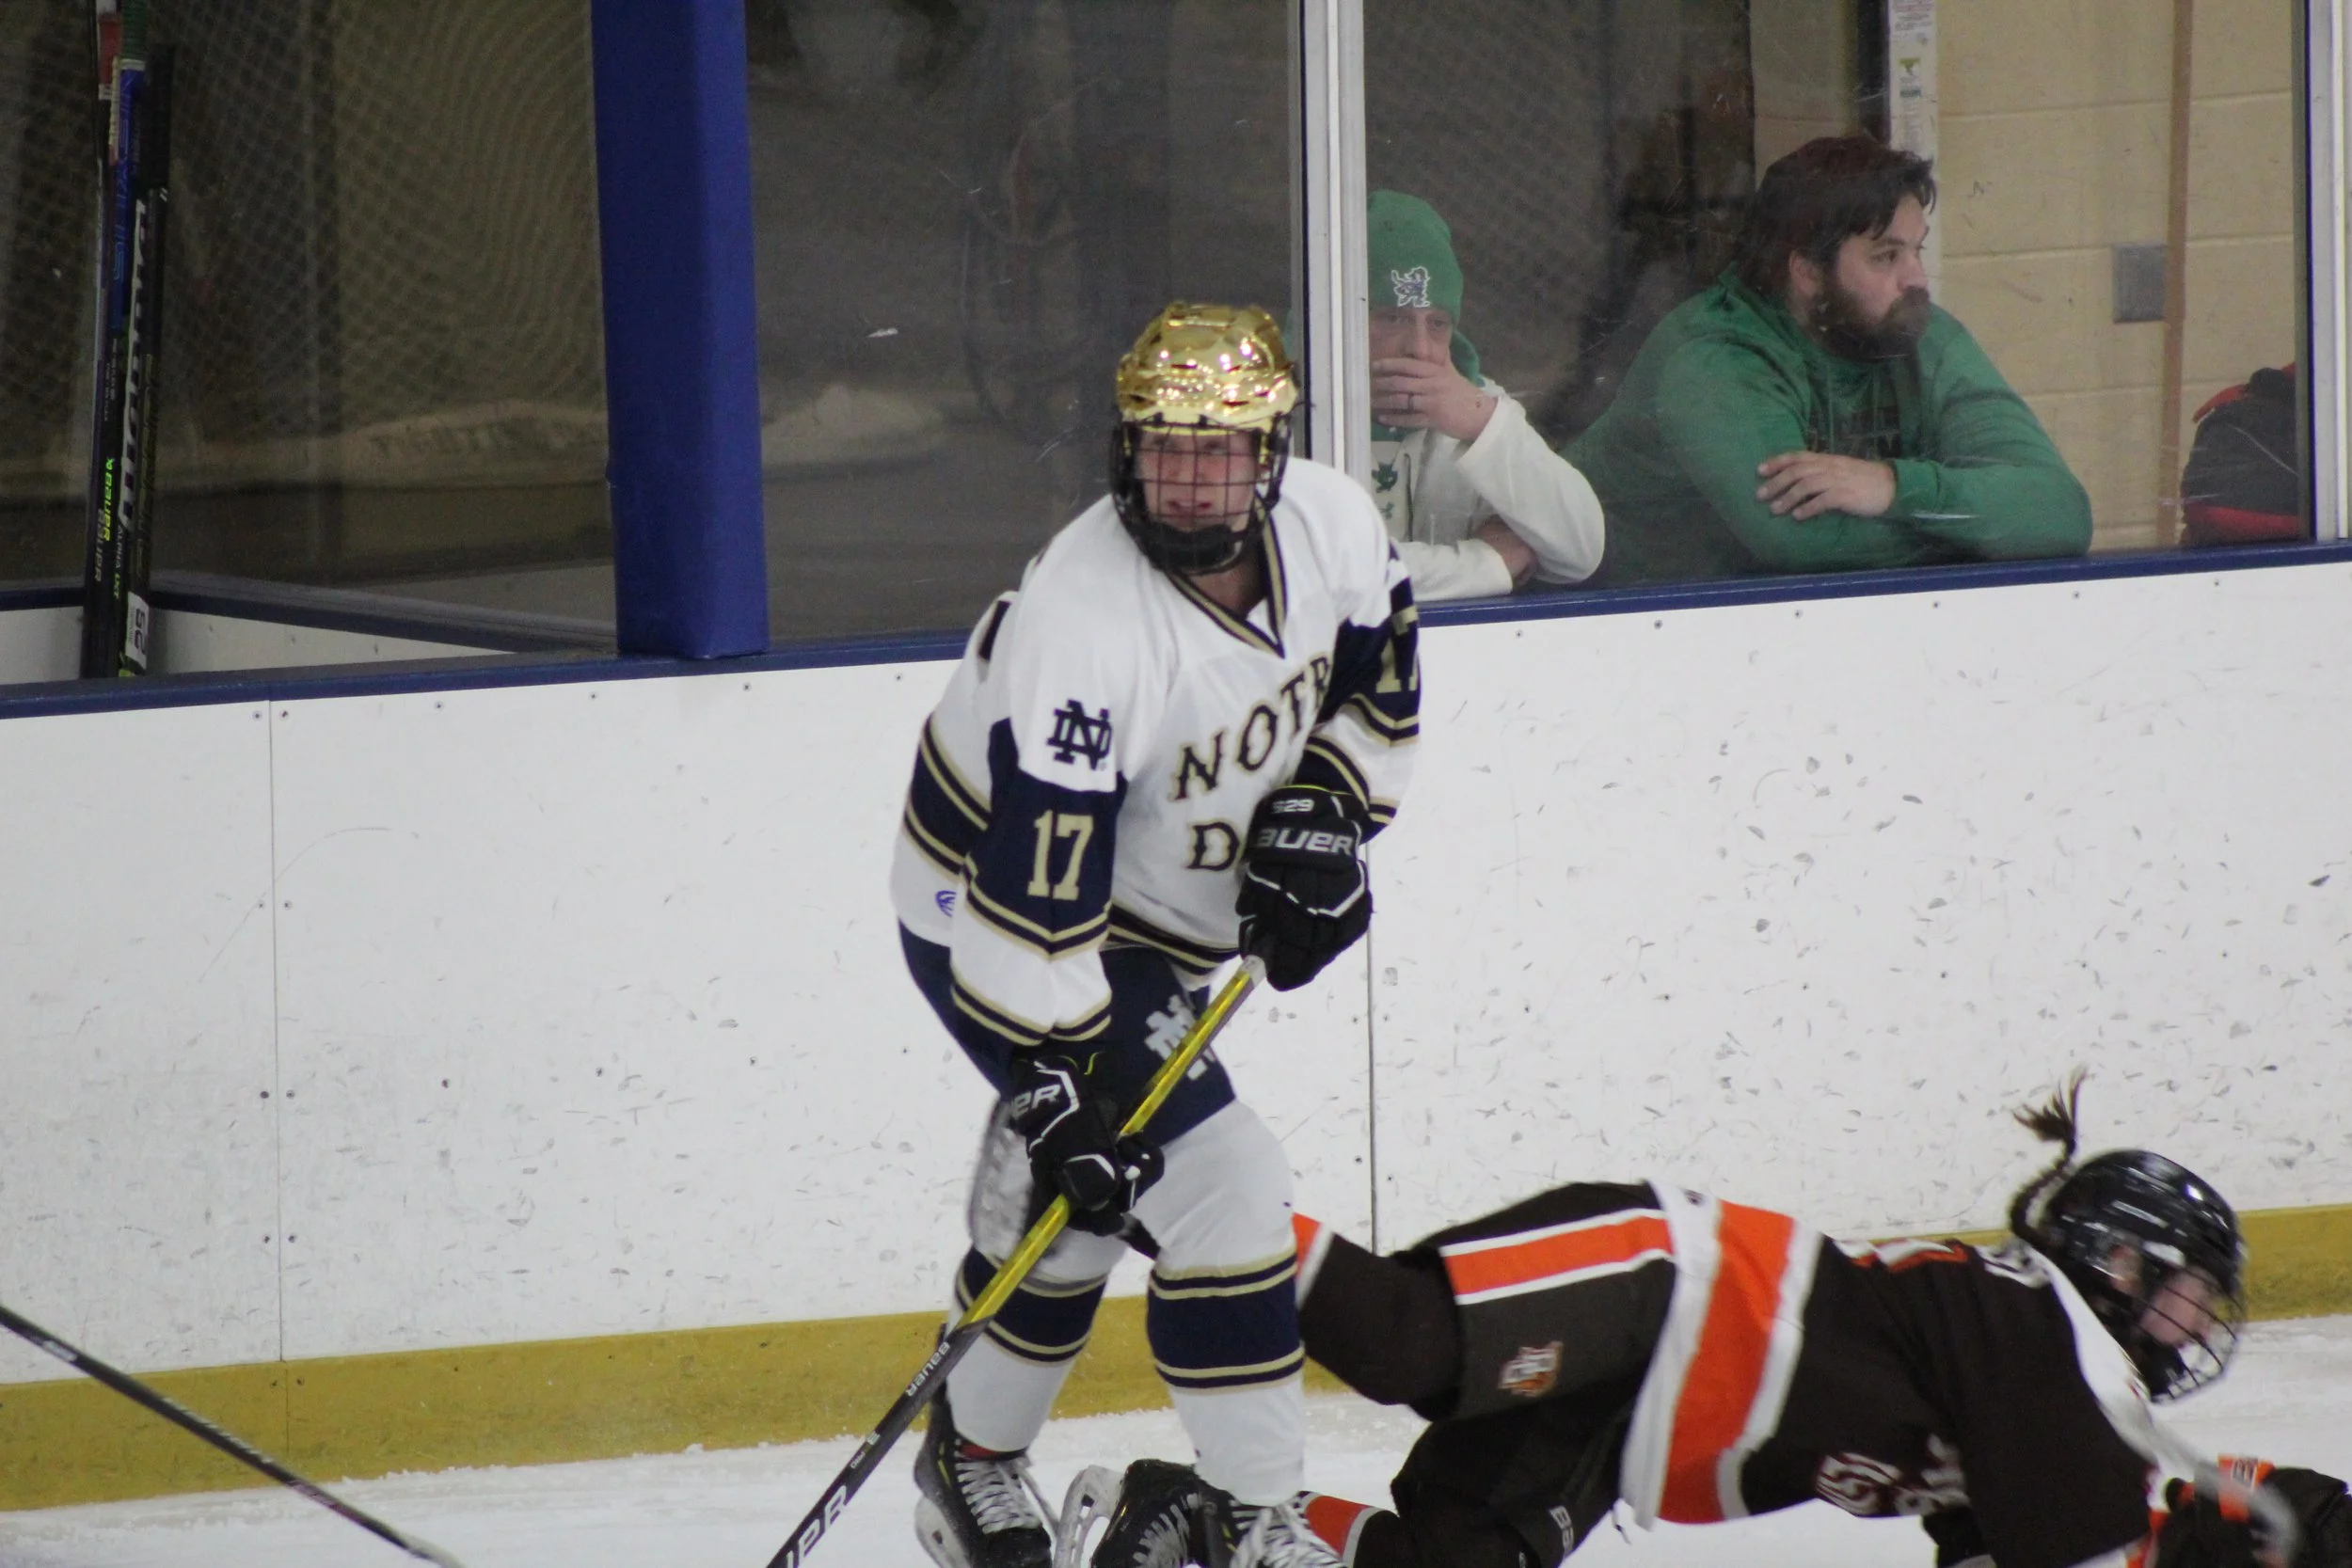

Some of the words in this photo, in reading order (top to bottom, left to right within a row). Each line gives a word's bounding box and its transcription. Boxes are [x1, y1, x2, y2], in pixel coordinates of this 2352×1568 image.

[1170, 653, 1332, 801] NOTR
[1026, 809, 1094, 901] 17
[1256, 828, 1355, 857] AUER
[905, 1341, 950, 1397] BAUER
